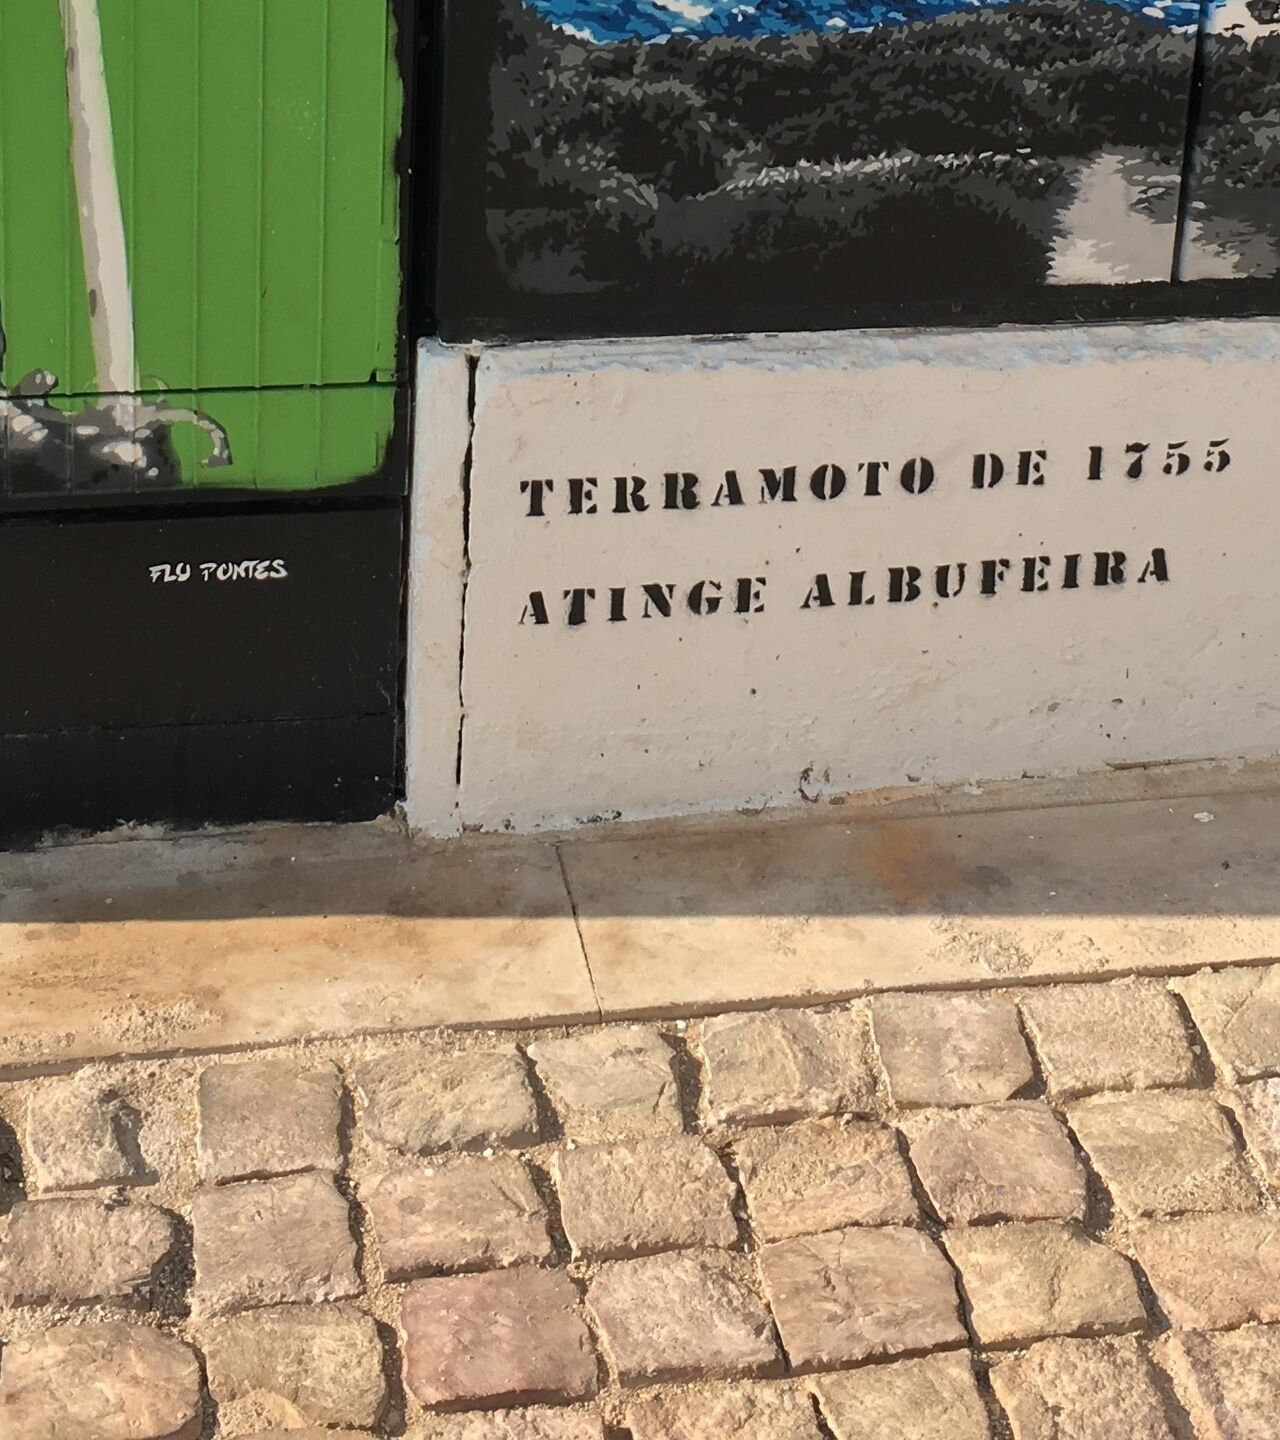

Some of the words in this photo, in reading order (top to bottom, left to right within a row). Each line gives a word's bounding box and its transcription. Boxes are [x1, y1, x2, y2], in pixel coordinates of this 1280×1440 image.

[520, 456, 935, 517] TERRAMOTO
[972, 449, 1047, 490] DE
[1087, 438, 1232, 481] 1755
[199, 559, 288, 582] PONTES
[518, 576, 768, 626] ATINGE
[799, 547, 1170, 609] ALBUFEIRA
